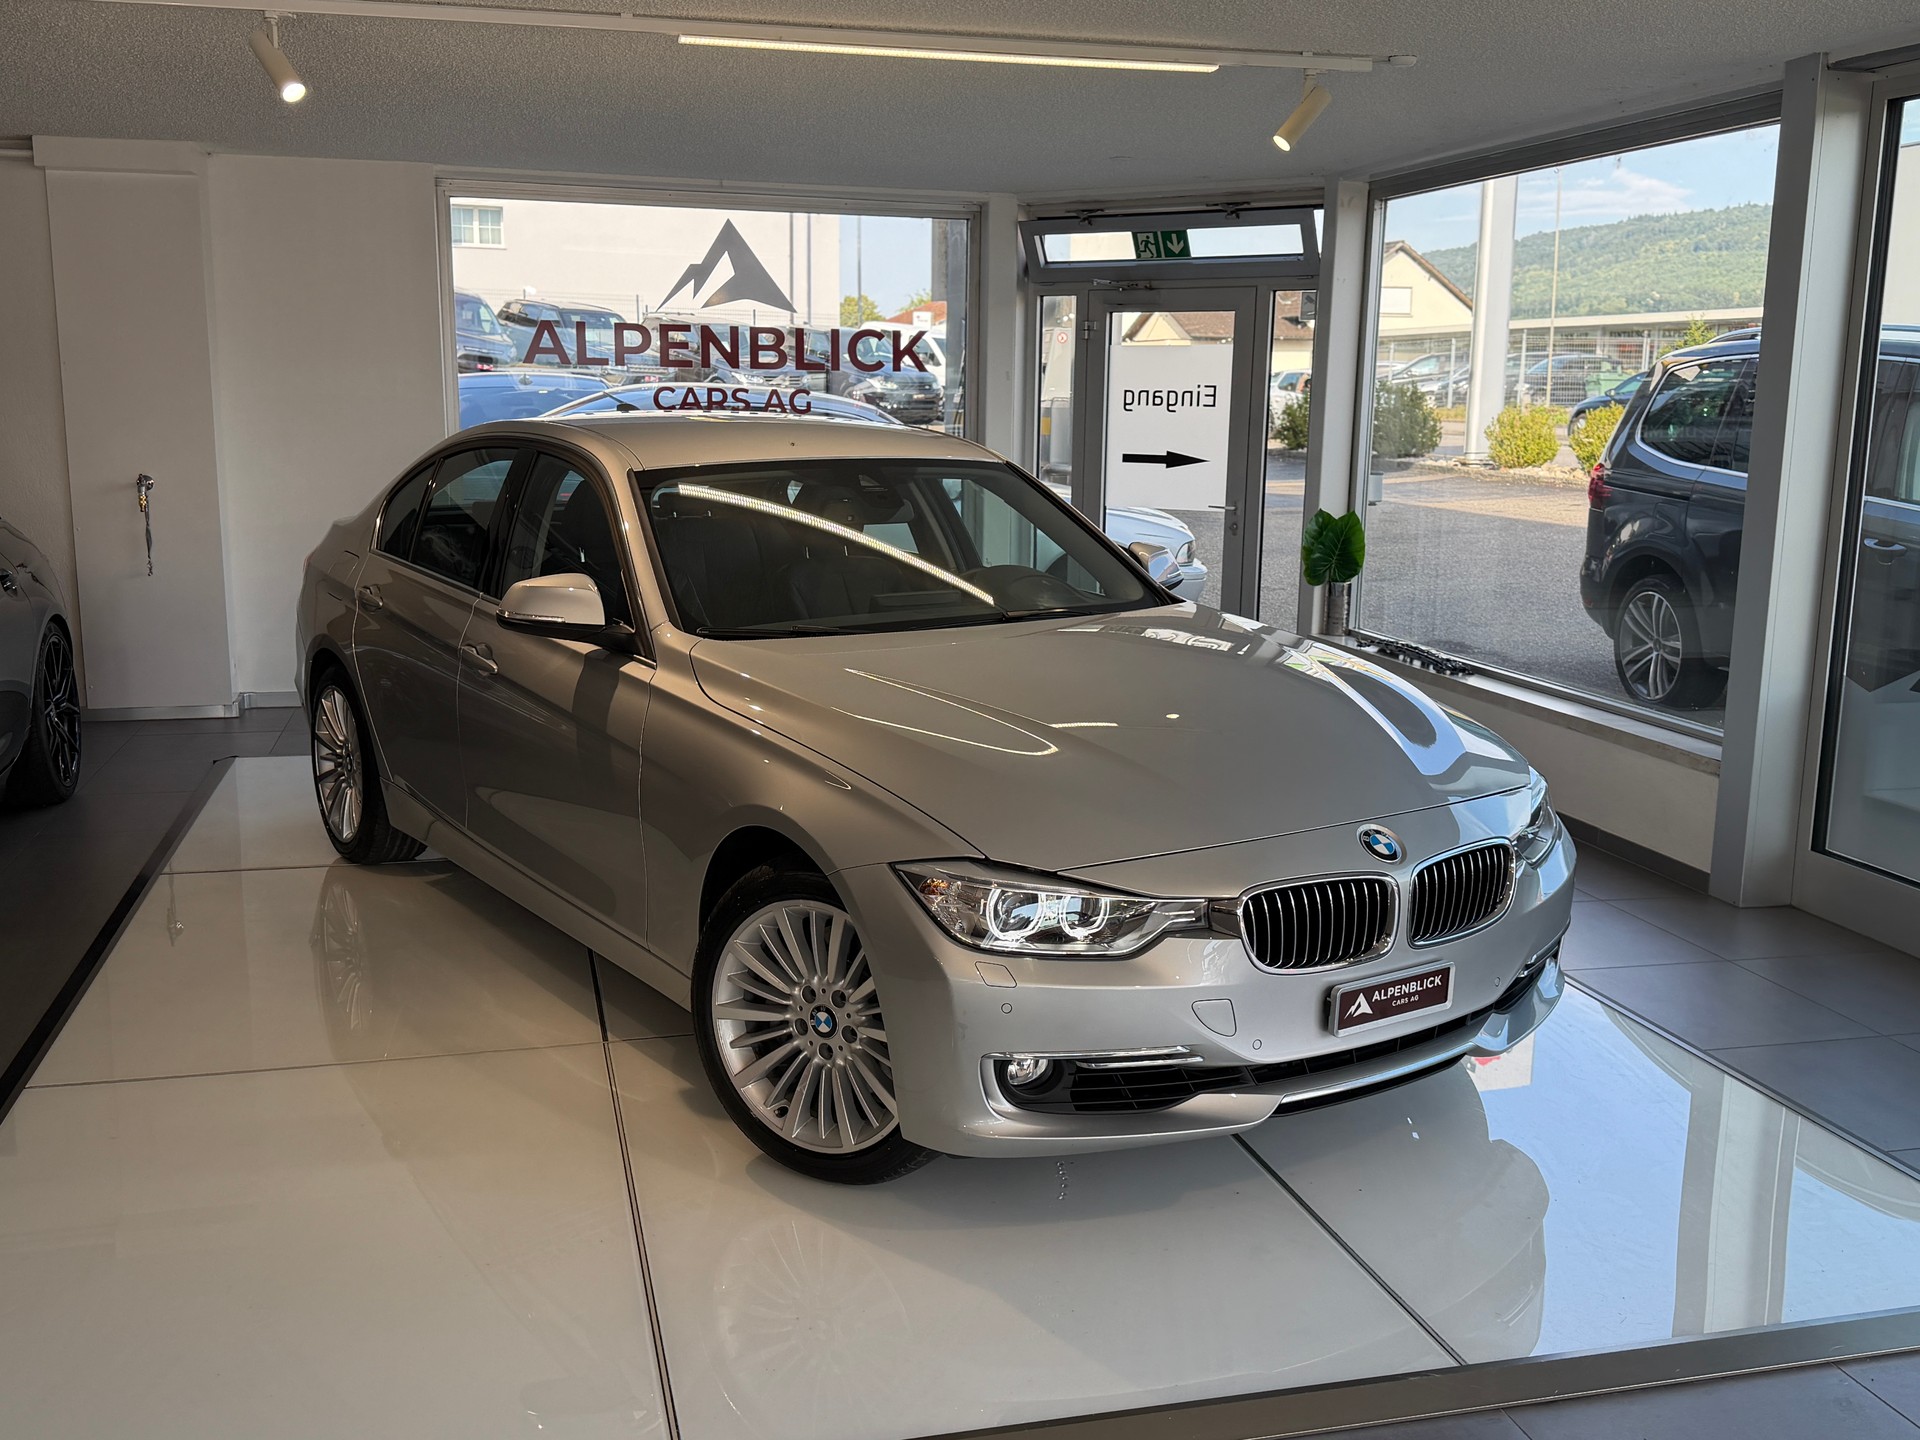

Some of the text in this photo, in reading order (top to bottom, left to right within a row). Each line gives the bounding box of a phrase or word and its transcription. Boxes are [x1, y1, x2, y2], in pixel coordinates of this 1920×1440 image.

[522, 319, 929, 373] ALPENBLICK
[653, 386, 813, 415] CARS AG
[1372, 974, 1443, 1003] ALPENBLICK
[1391, 994, 1420, 1007] CARS AG
